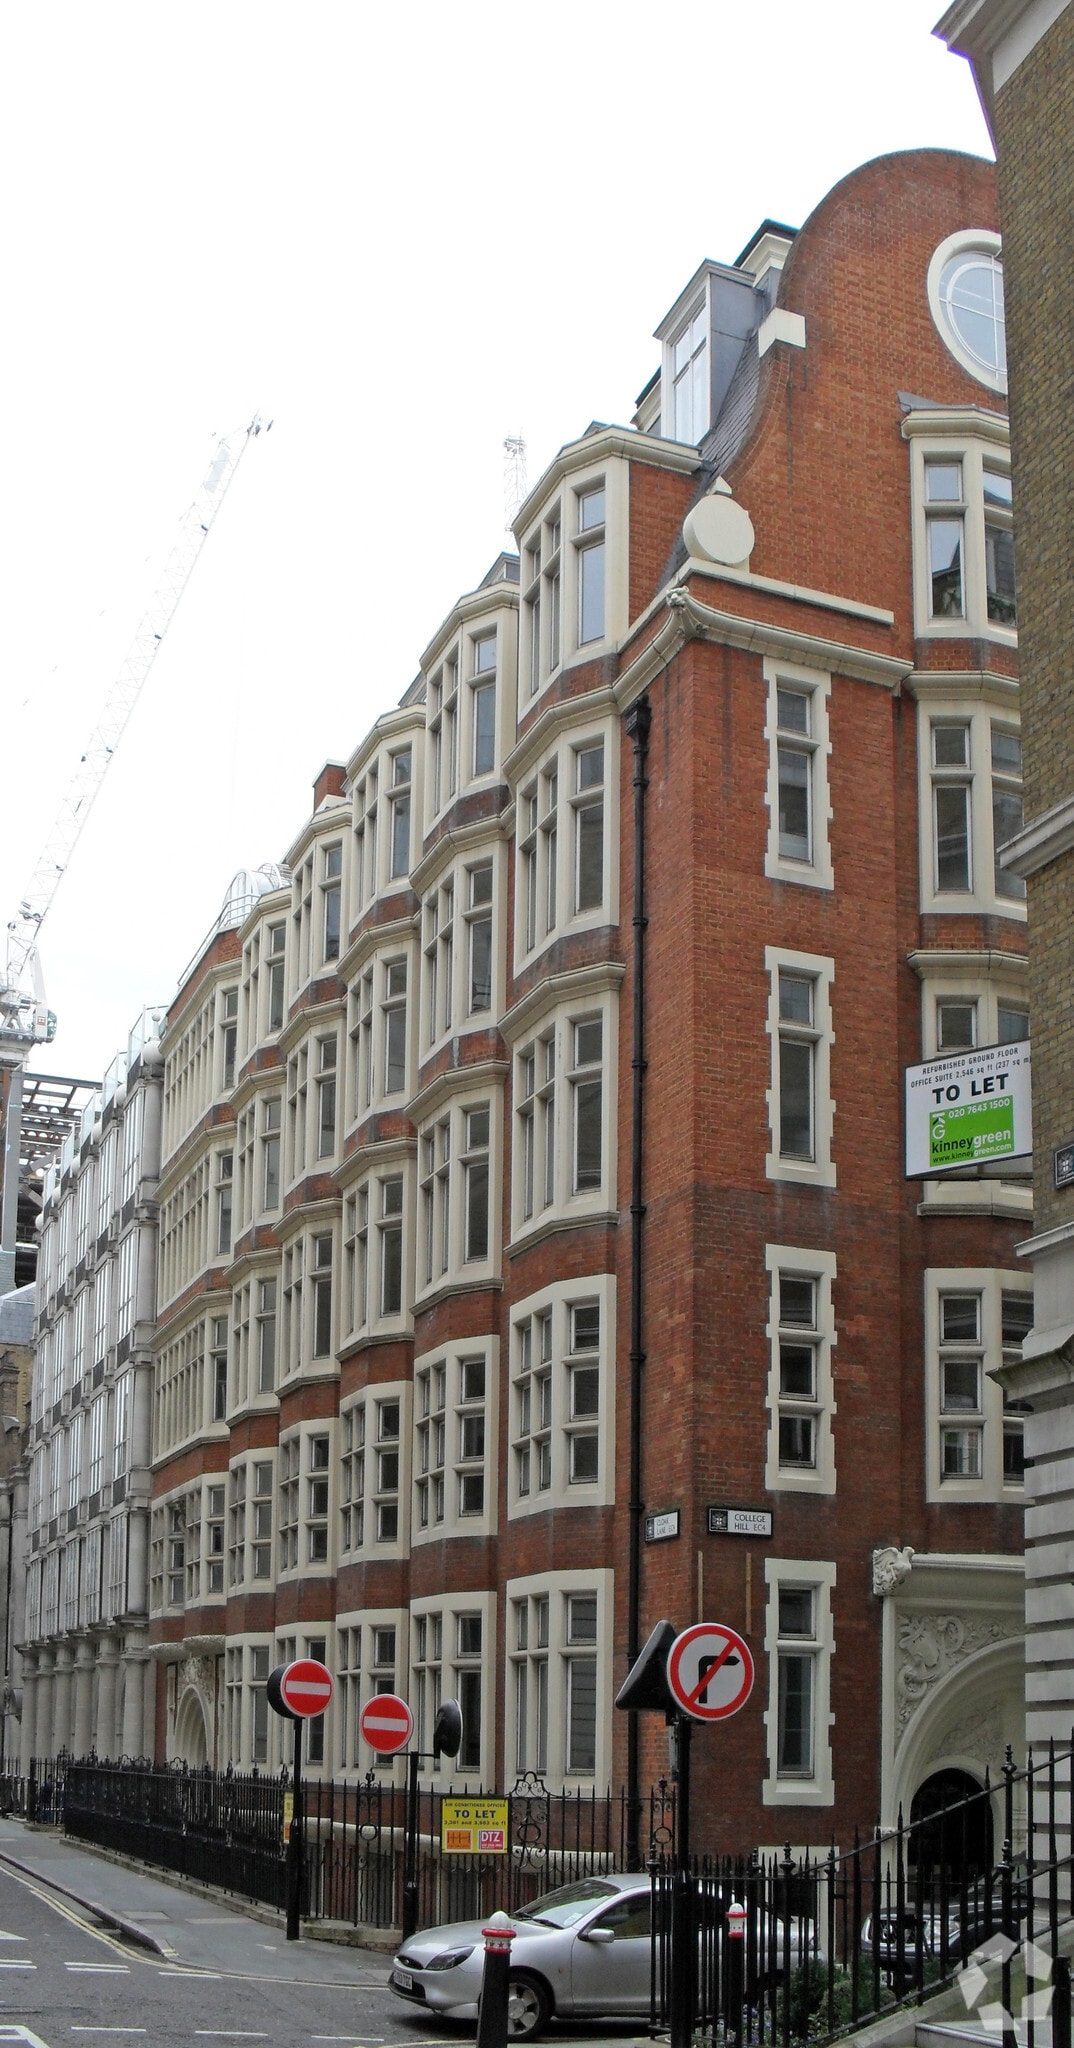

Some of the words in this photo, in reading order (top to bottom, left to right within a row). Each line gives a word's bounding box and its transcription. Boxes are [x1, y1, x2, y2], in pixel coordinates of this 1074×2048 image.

[922, 1059, 966, 1075] REFURBISHED
[968, 1053, 995, 1065] GROUND
[997, 1047, 1019, 1058] FLOOR
[910, 1077, 932, 1089] OFFICE
[935, 1072, 953, 1084] SUITE
[976, 1066, 985, 1074] sq
[987, 1063, 993, 1072] ft
[995, 1060, 1010, 1071] (237
[1012, 1058, 1021, 1066] sq
[932, 1084, 960, 1104] TO
[971, 1073, 1009, 1097] LET
[948, 1109, 965, 1119] 020
[967, 1103, 988, 1115] 7643
[990, 1097, 1010, 1110] 1500
[932, 1129, 1011, 1154] kinneygreen
[932, 1142, 1012, 1163] www.kinneygreen.com
[734, 1513, 766, 1523] COLLEGE
[734, 1522, 749, 1531] HILL
[753, 1523, 766, 1531] EC4
[454, 1809, 470, 1819] TO
[475, 1810, 496, 1819] LET
[481, 1831, 501, 1843] DTZ
